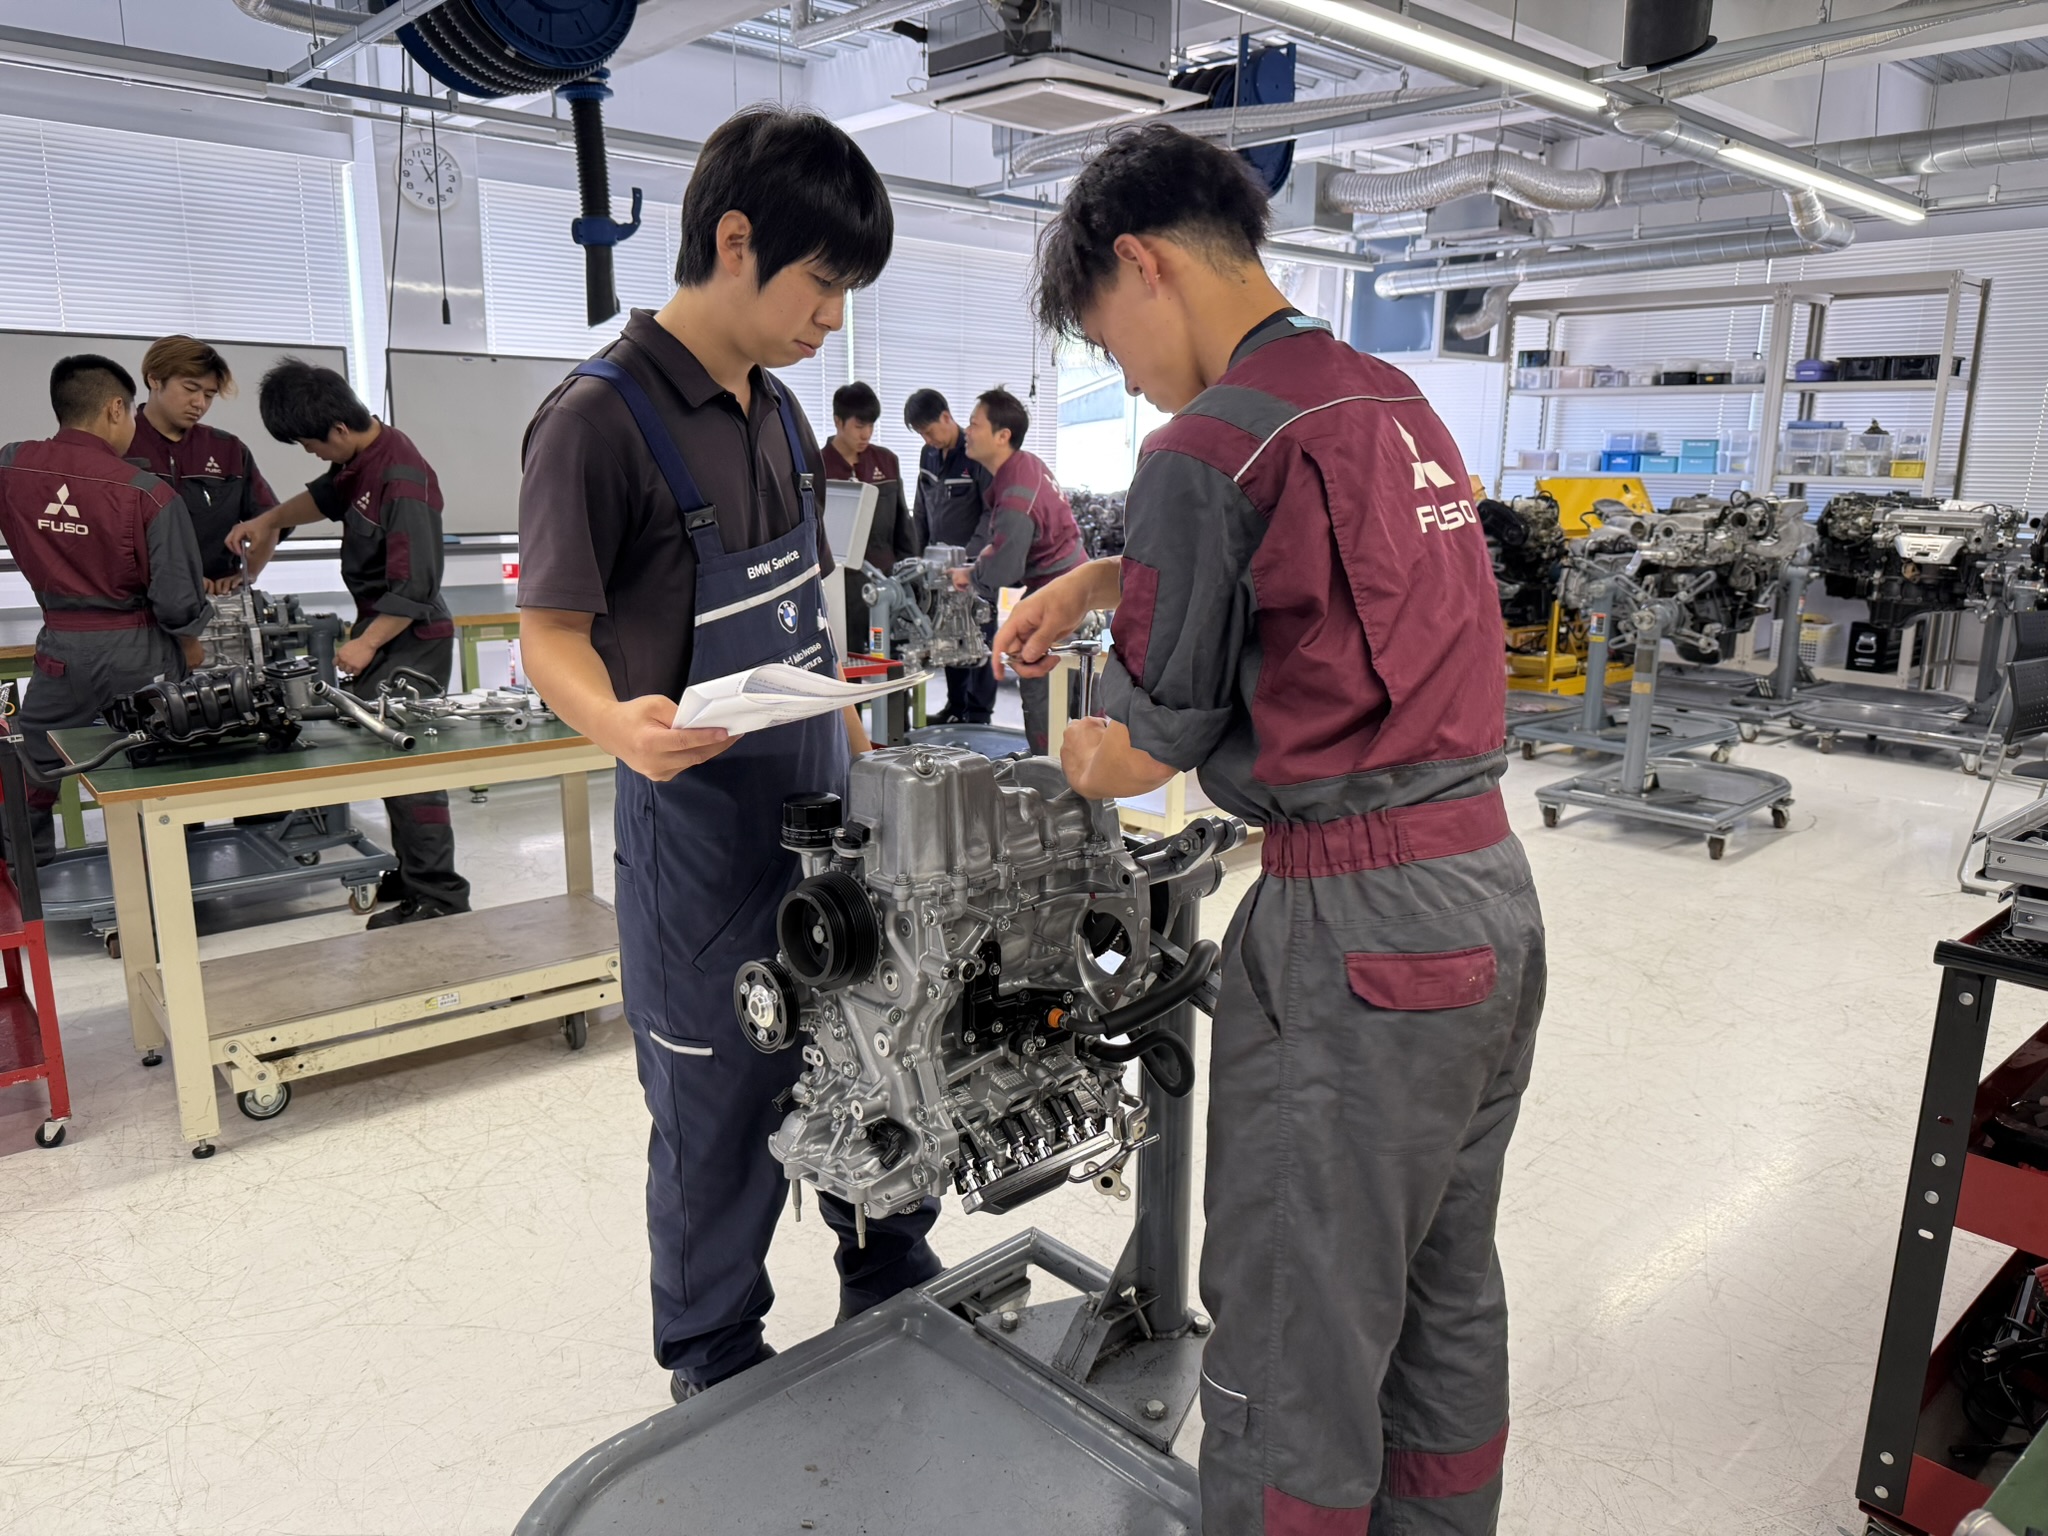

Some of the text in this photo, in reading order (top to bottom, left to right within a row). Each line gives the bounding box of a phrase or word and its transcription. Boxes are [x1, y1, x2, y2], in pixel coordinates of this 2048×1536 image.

[412, 150, 421, 158] 11
[423, 148, 432, 156] 12
[404, 158, 414, 166] 10
[445, 163, 452, 171] 2
[448, 175, 456, 183] 3
[406, 182, 414, 190] 8
[427, 197, 435, 205] 6
[439, 194, 447, 202] 5
[1416, 500, 1477, 533] FUSO
[38, 519, 89, 535] FUSO
[747, 550, 800, 579] BMW Service
